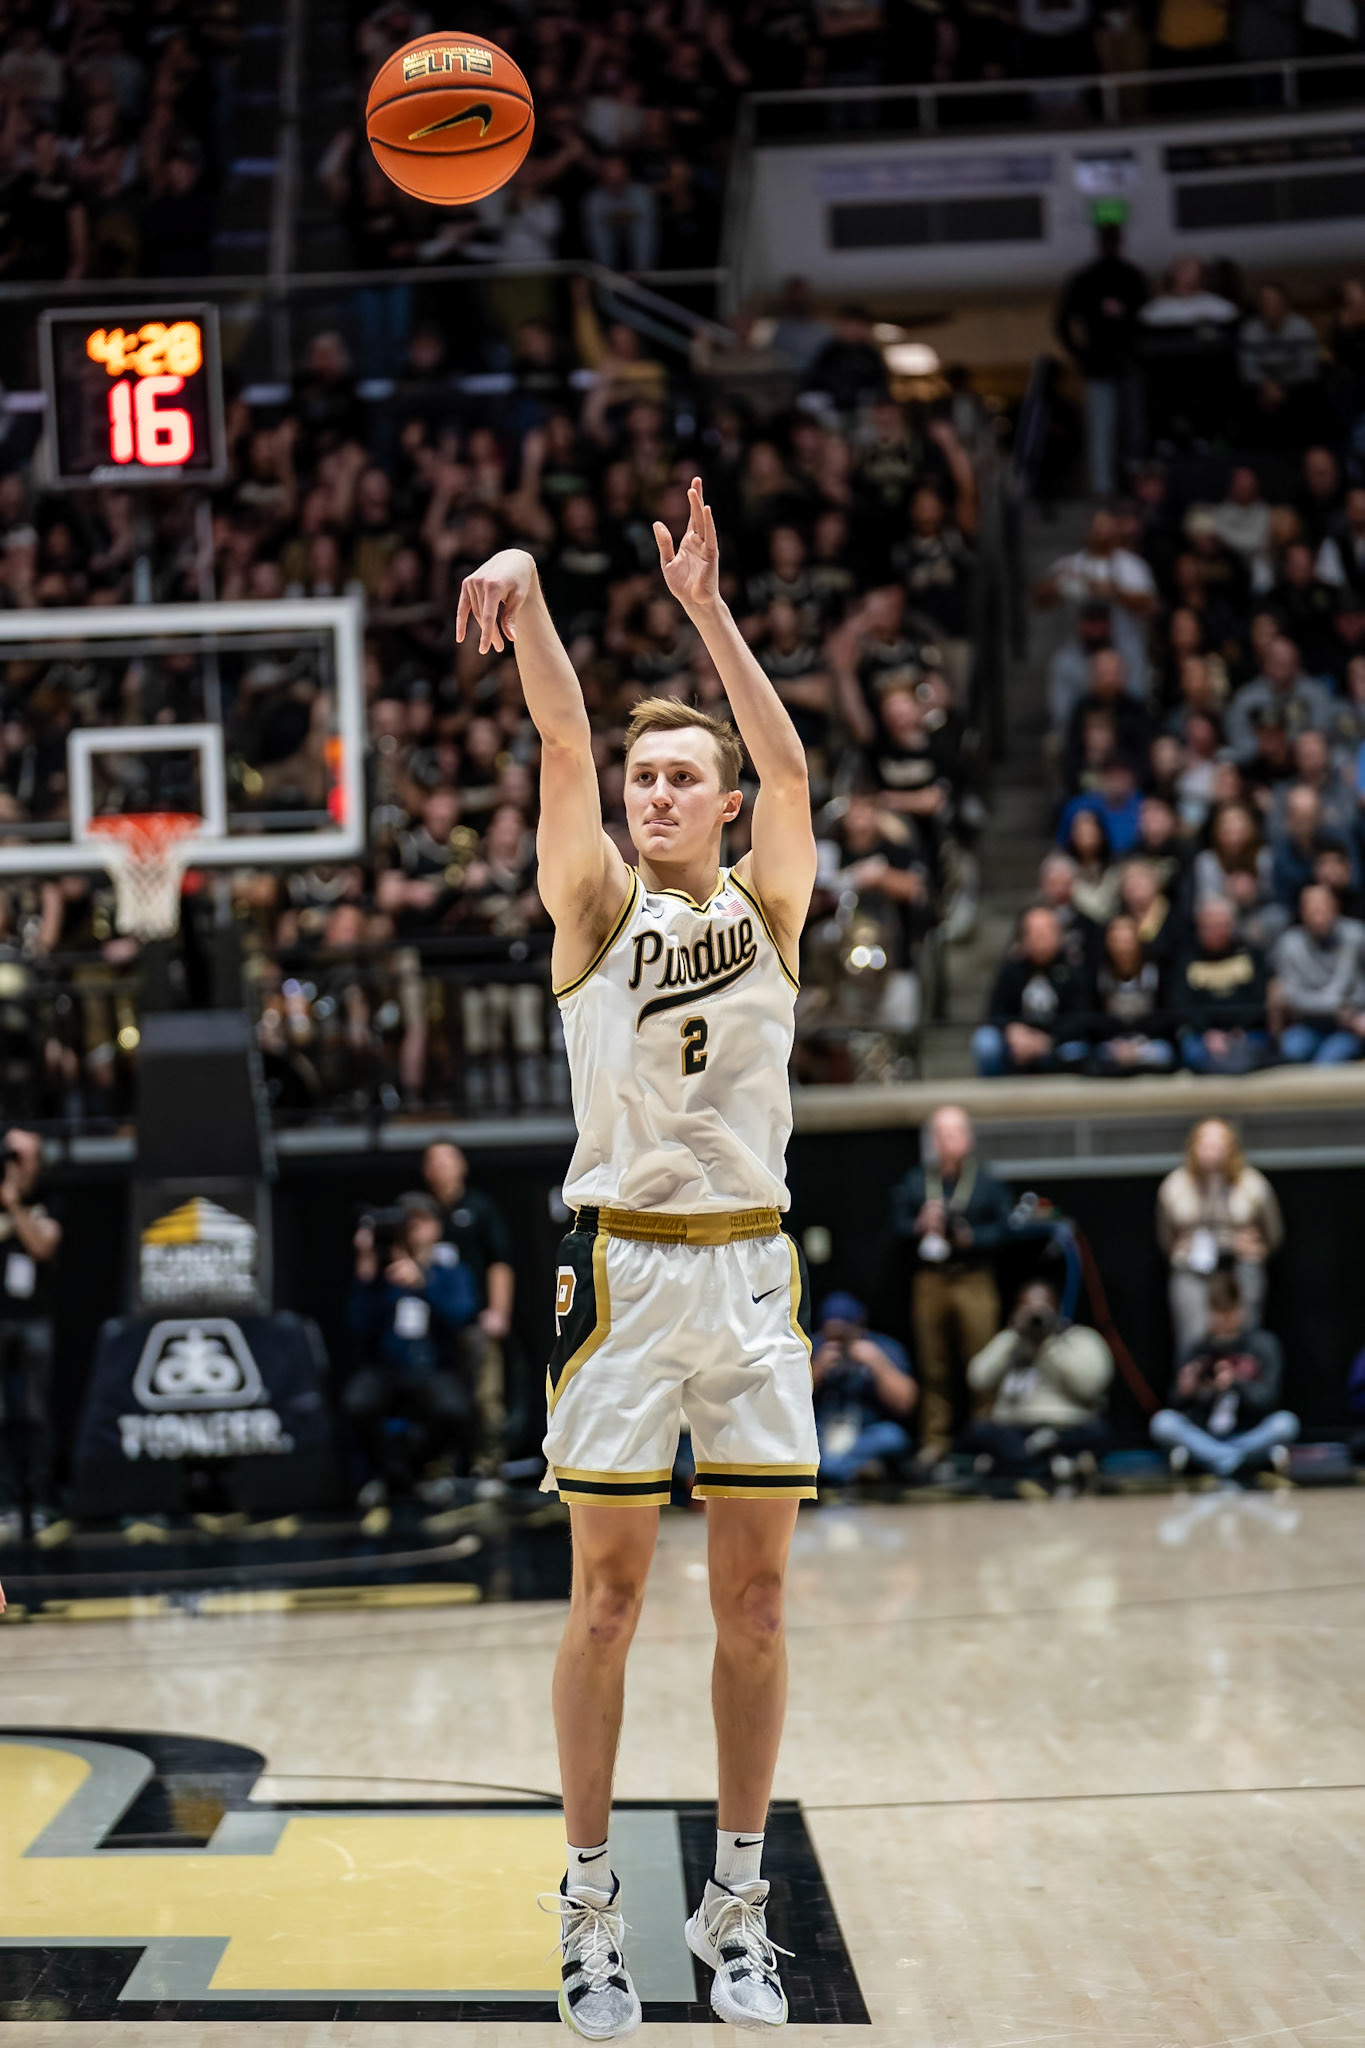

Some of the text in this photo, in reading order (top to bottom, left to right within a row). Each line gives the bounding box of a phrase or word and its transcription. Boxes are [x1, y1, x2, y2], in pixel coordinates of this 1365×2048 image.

[403, 52, 492, 83] ELITE
[86, 321, 203, 377] 4:28
[108, 375, 194, 466] 16
[628, 916, 757, 991] Purdue
[680, 1015, 709, 1076] 2
